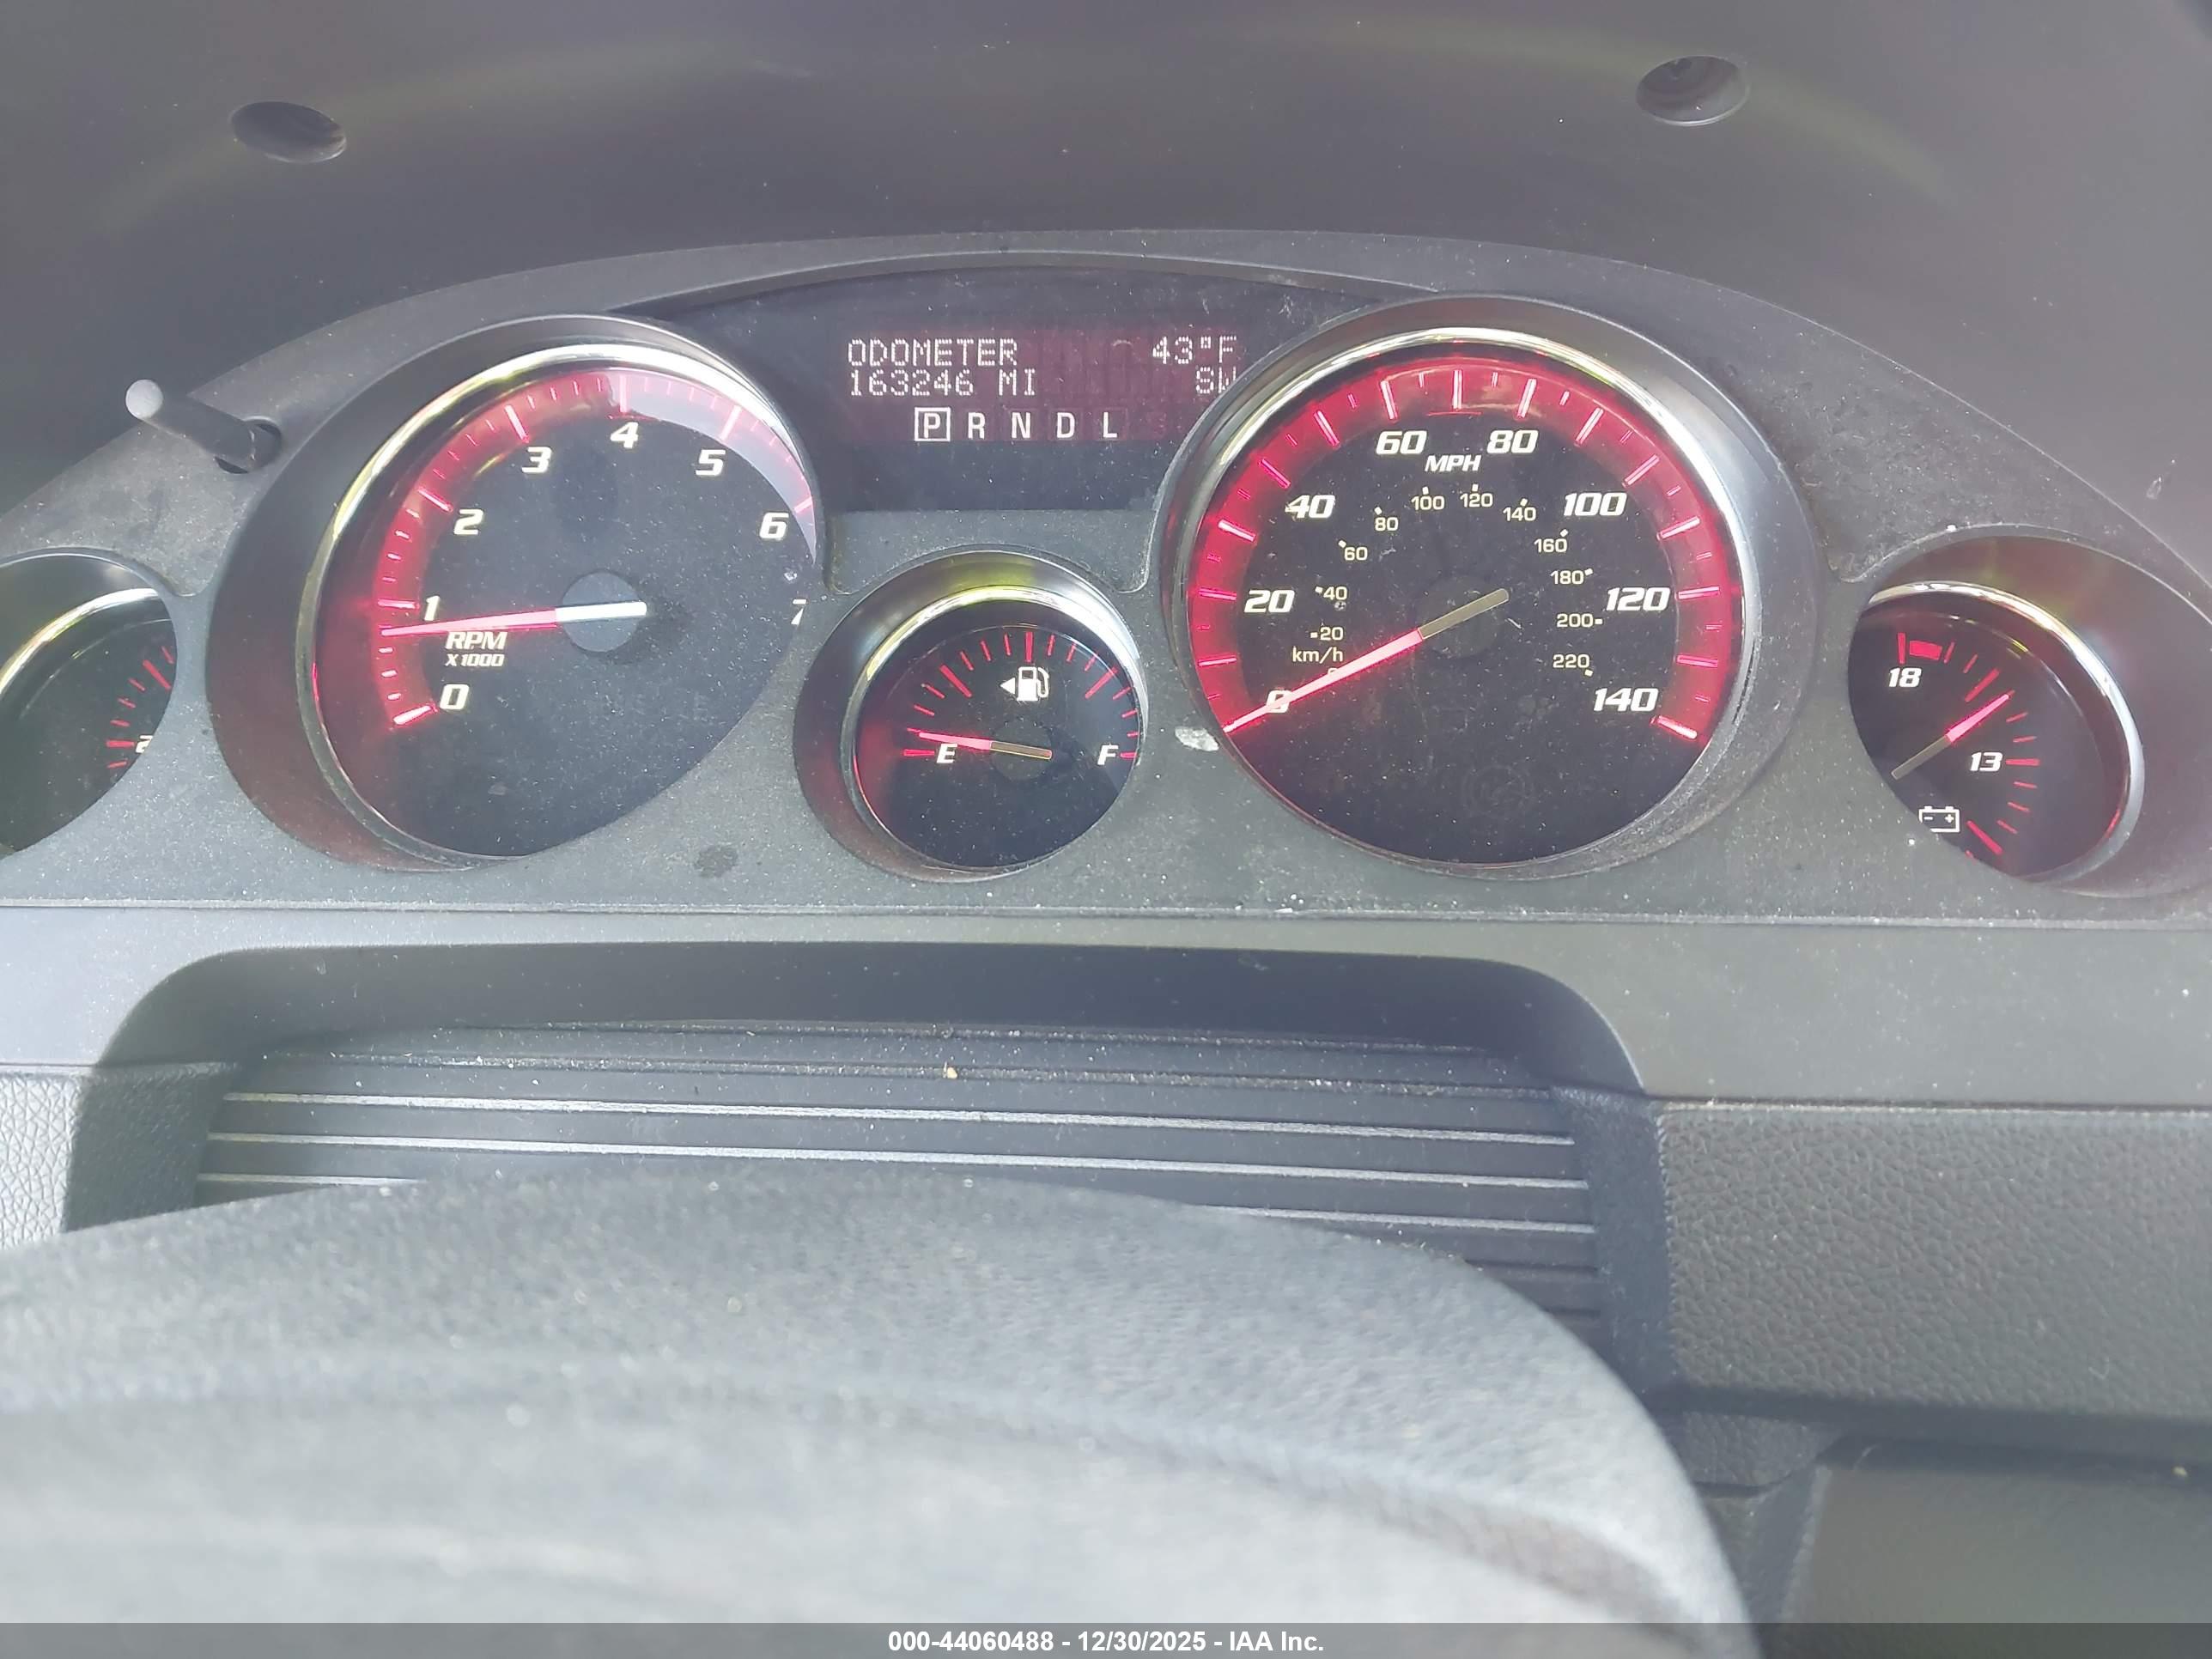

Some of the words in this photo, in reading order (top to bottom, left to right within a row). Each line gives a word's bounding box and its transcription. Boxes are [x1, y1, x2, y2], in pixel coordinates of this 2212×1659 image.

[848, 337, 1018, 367] ODOMETER
[851, 369, 974, 397] 163246
[998, 368, 1036, 396] MI
[610, 422, 639, 449] 4
[923, 413, 942, 439] P
[968, 411, 986, 440] R
[1012, 411, 1031, 439] N
[1056, 412, 1075, 439] D
[1103, 411, 1118, 439] L
[1376, 430, 1427, 455] 60
[1486, 429, 1539, 454] 80
[521, 447, 552, 474] 3
[695, 449, 726, 477] 5
[1425, 454, 1482, 472] MPH
[1285, 495, 1336, 519] 40
[1411, 495, 1445, 511] 100
[1460, 492, 1493, 507] 120
[1563, 492, 1627, 517] 100
[453, 508, 484, 535] 2
[1375, 516, 1399, 532] 80
[1503, 507, 1536, 521] 140
[759, 512, 789, 541] 6
[1341, 544, 1368, 561] 60
[1534, 538, 1568, 553] 160
[1550, 569, 1584, 585] 180
[1243, 589, 1296, 613] 20
[1322, 586, 1348, 601] 40
[1606, 586, 1671, 612] 120
[423, 595, 441, 622] 1
[1556, 613, 1594, 628] 200
[445, 631, 508, 649] RPM
[1320, 626, 1344, 641] 20
[1292, 647, 1343, 665] km/h
[1553, 653, 1590, 669] 220
[1888, 667, 1922, 688] 18
[439, 684, 470, 710] 0
[1266, 690, 1291, 713] 0
[1593, 688, 1659, 712] 140
[936, 741, 960, 764] E
[1097, 743, 1119, 766] F
[1970, 751, 2003, 772] 13
